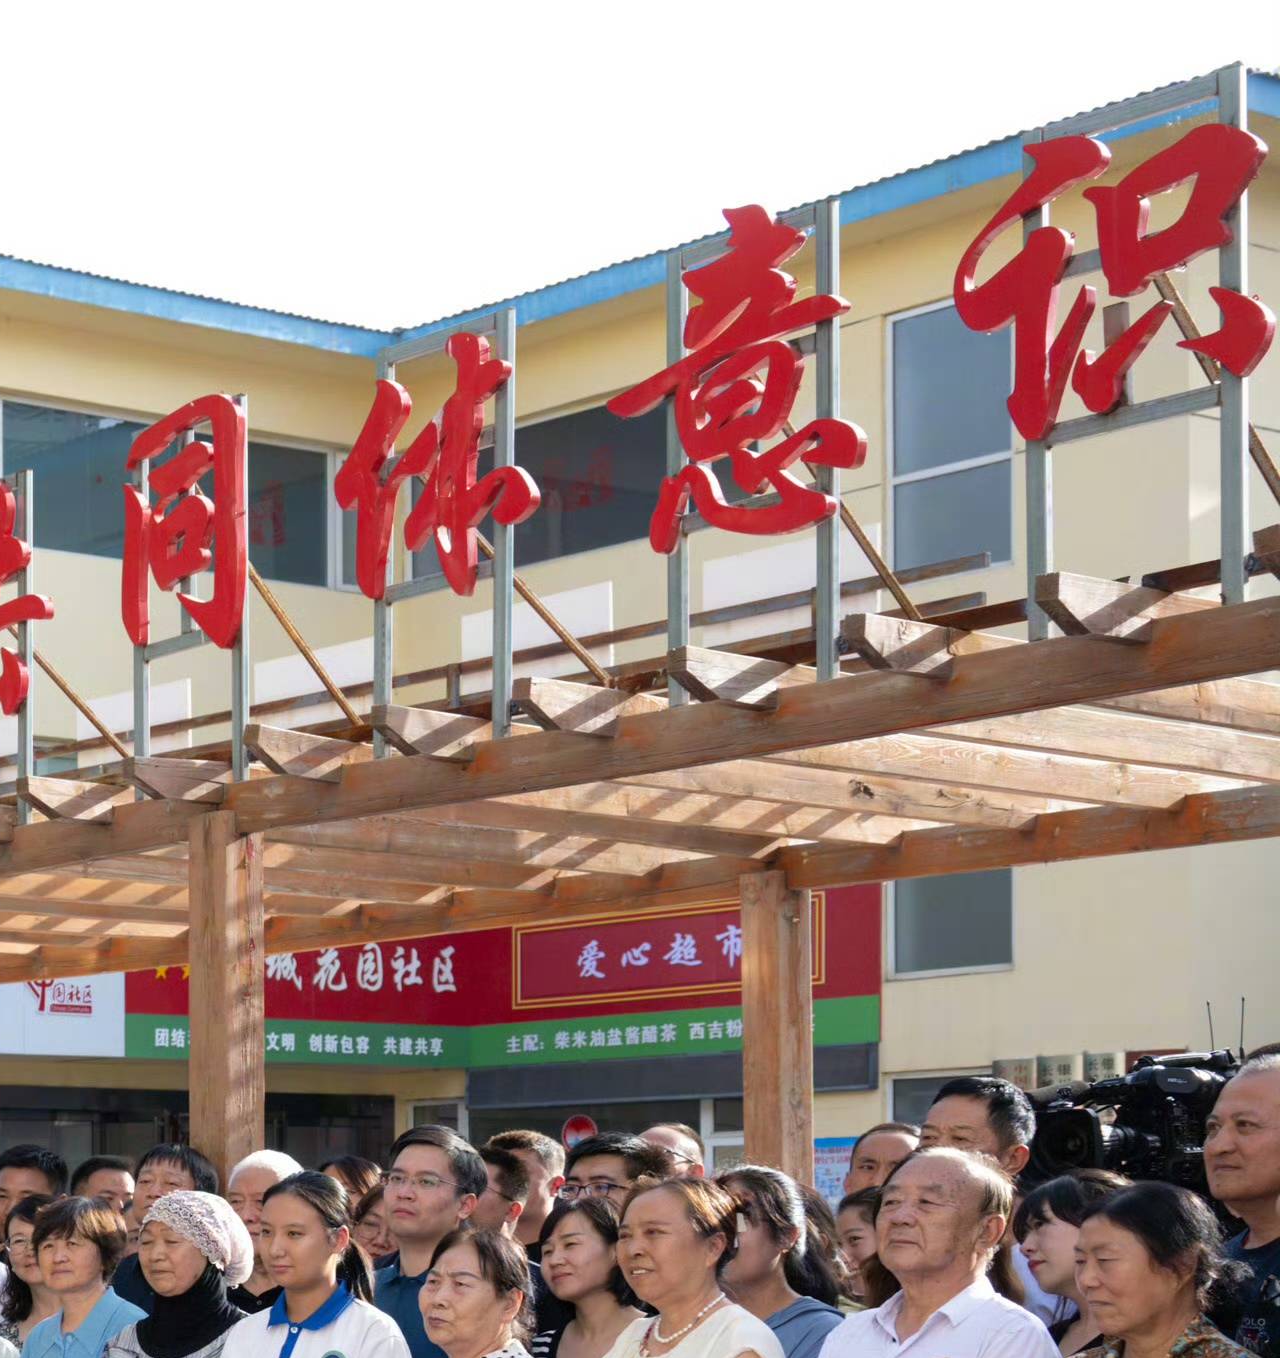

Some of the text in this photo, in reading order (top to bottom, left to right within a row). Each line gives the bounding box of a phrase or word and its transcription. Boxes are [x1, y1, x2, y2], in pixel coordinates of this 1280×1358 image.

[576, 924, 743, 979] 爱心超市
[154, 1028, 444, 1056] 团结 文明 创新包容 共建共享
